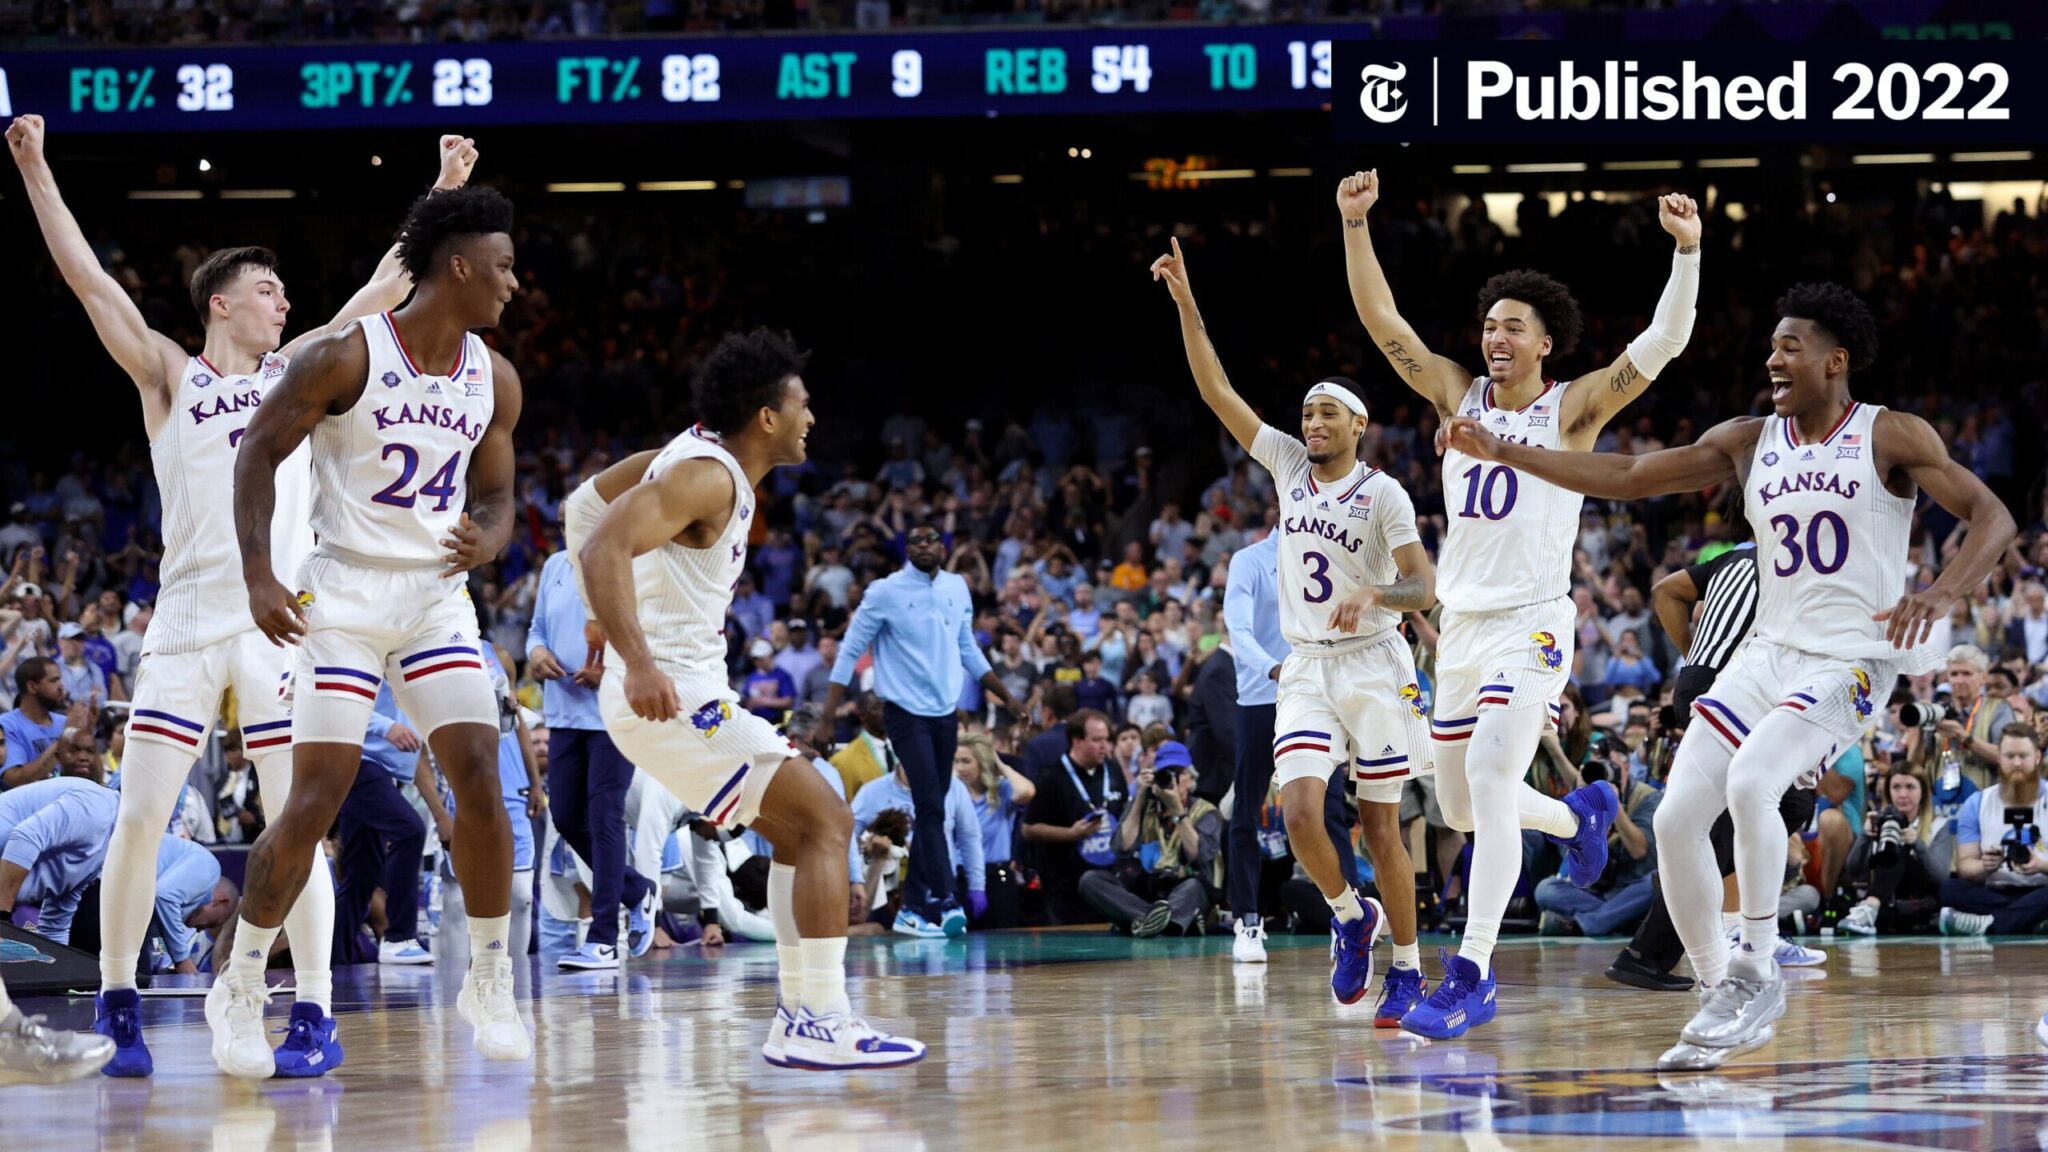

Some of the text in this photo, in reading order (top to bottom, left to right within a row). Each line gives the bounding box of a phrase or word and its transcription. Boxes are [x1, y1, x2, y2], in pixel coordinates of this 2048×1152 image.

[177, 63, 234, 112] 32
[433, 58, 493, 107] 23
[661, 53, 721, 102] 82
[777, 53, 858, 99] AST
[891, 49, 923, 97] 9
[985, 48, 1067, 94] REB
[1091, 45, 1152, 93] 54
[1203, 43, 1257, 90] TO
[1288, 40, 1332, 89] 13
[1383, 340, 1423, 382] FEAR
[189, 389, 262, 425] KANS
[372, 402, 483, 442] KANSAS
[371, 442, 462, 512] 24
[1458, 463, 1519, 521] 10
[1758, 471, 1861, 507] KANSAS
[1284, 515, 1364, 553] KANSAS
[1770, 510, 1850, 577] 30
[1303, 551, 1334, 604] 3
